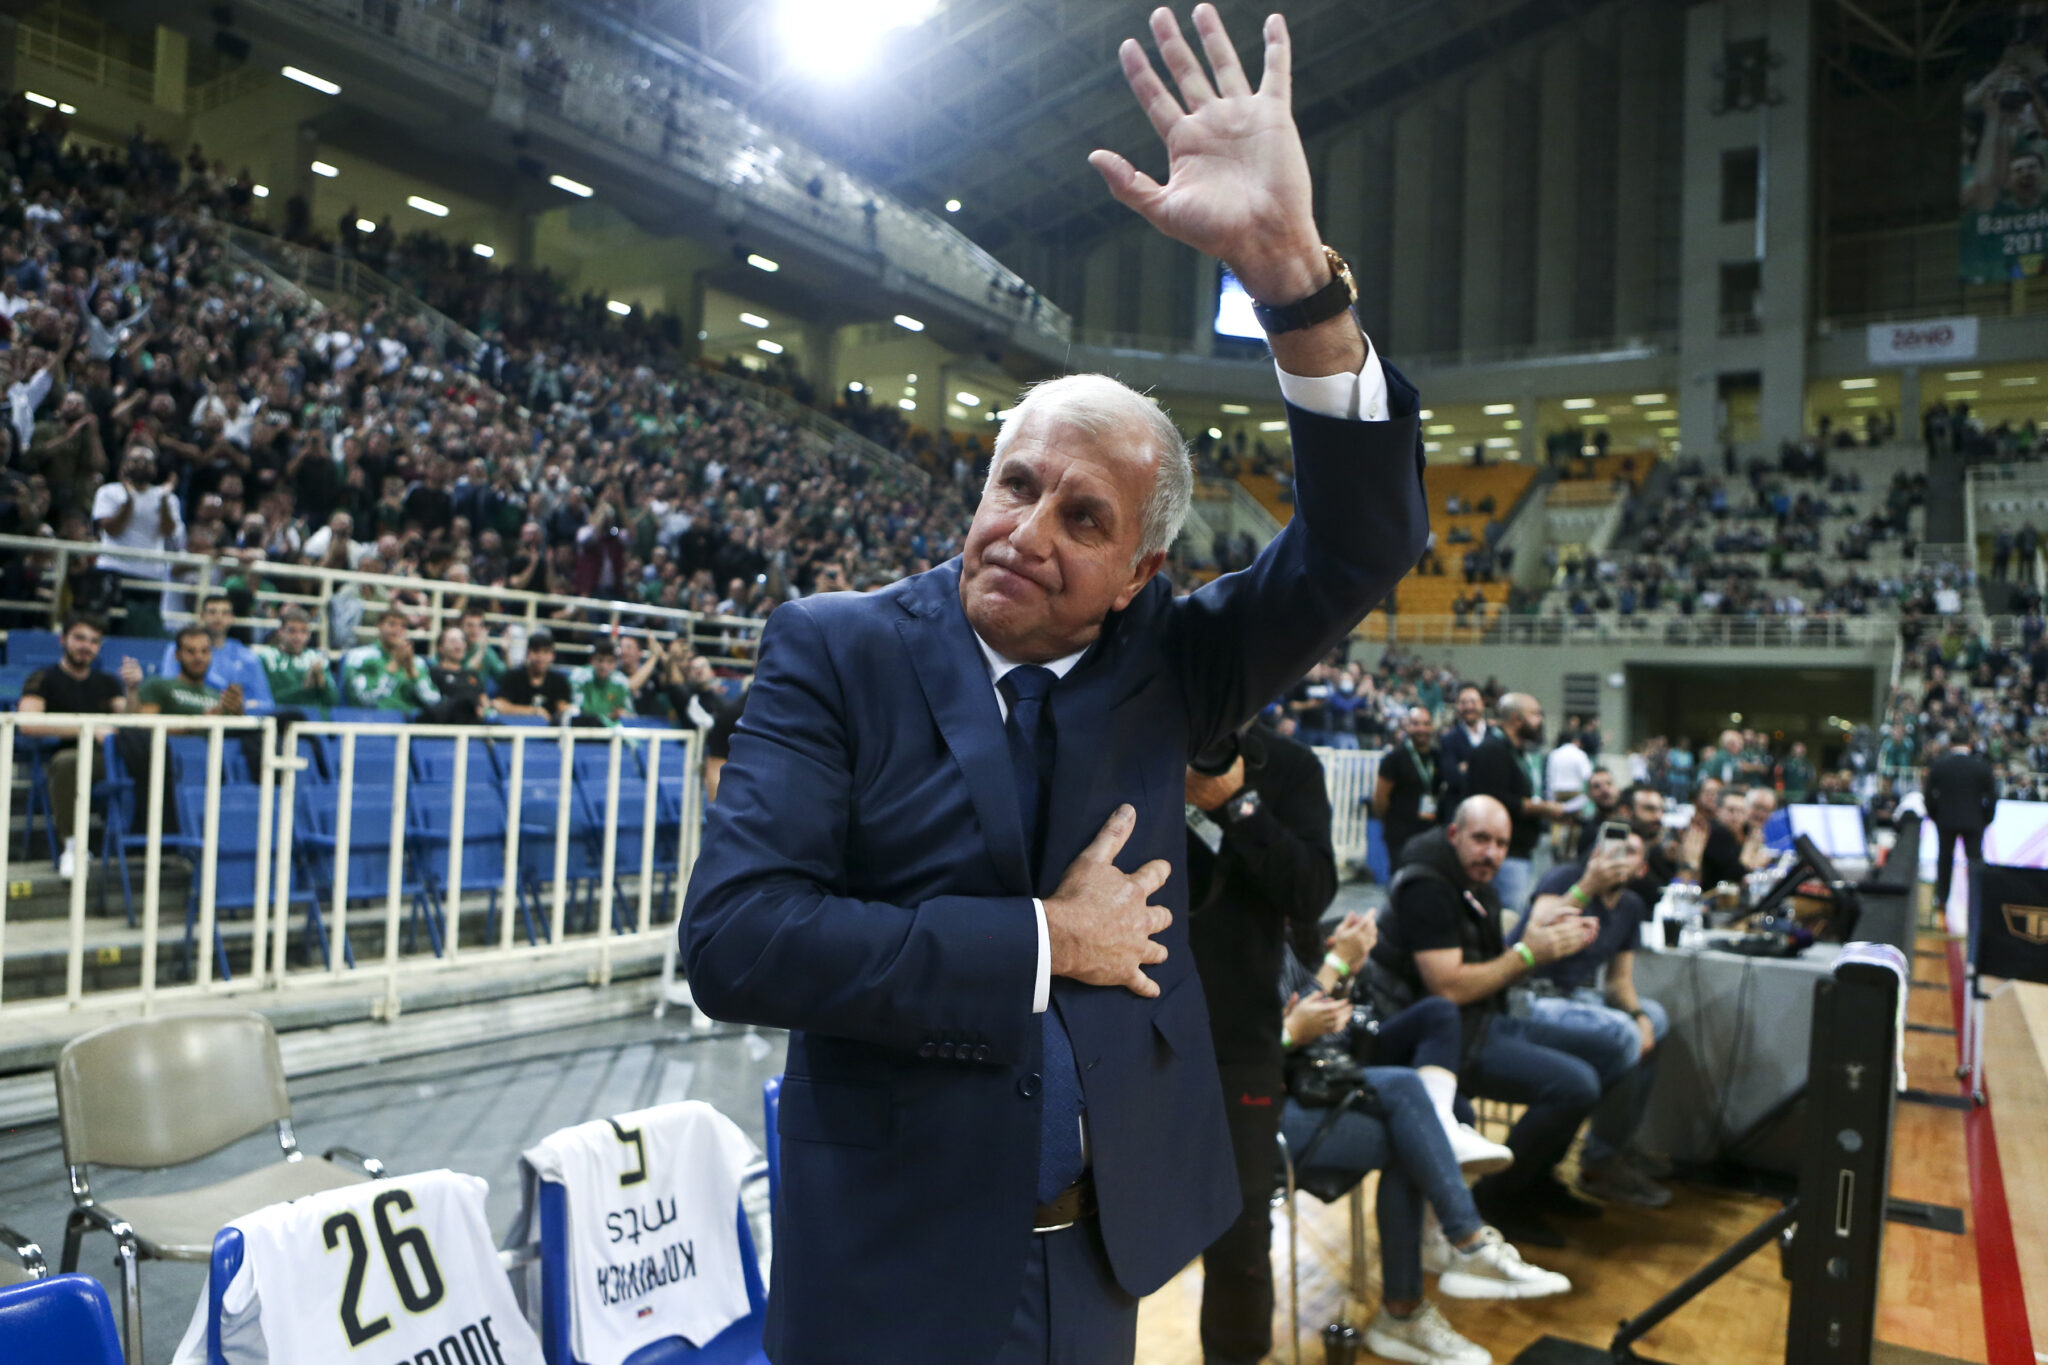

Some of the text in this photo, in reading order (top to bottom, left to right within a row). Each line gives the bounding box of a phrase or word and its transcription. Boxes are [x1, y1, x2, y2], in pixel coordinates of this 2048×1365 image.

[1977, 208, 2048, 236] Barcel
[2002, 231, 2048, 255] 201
[606, 1193, 678, 1245] mts
[321, 1187, 446, 1351] 26
